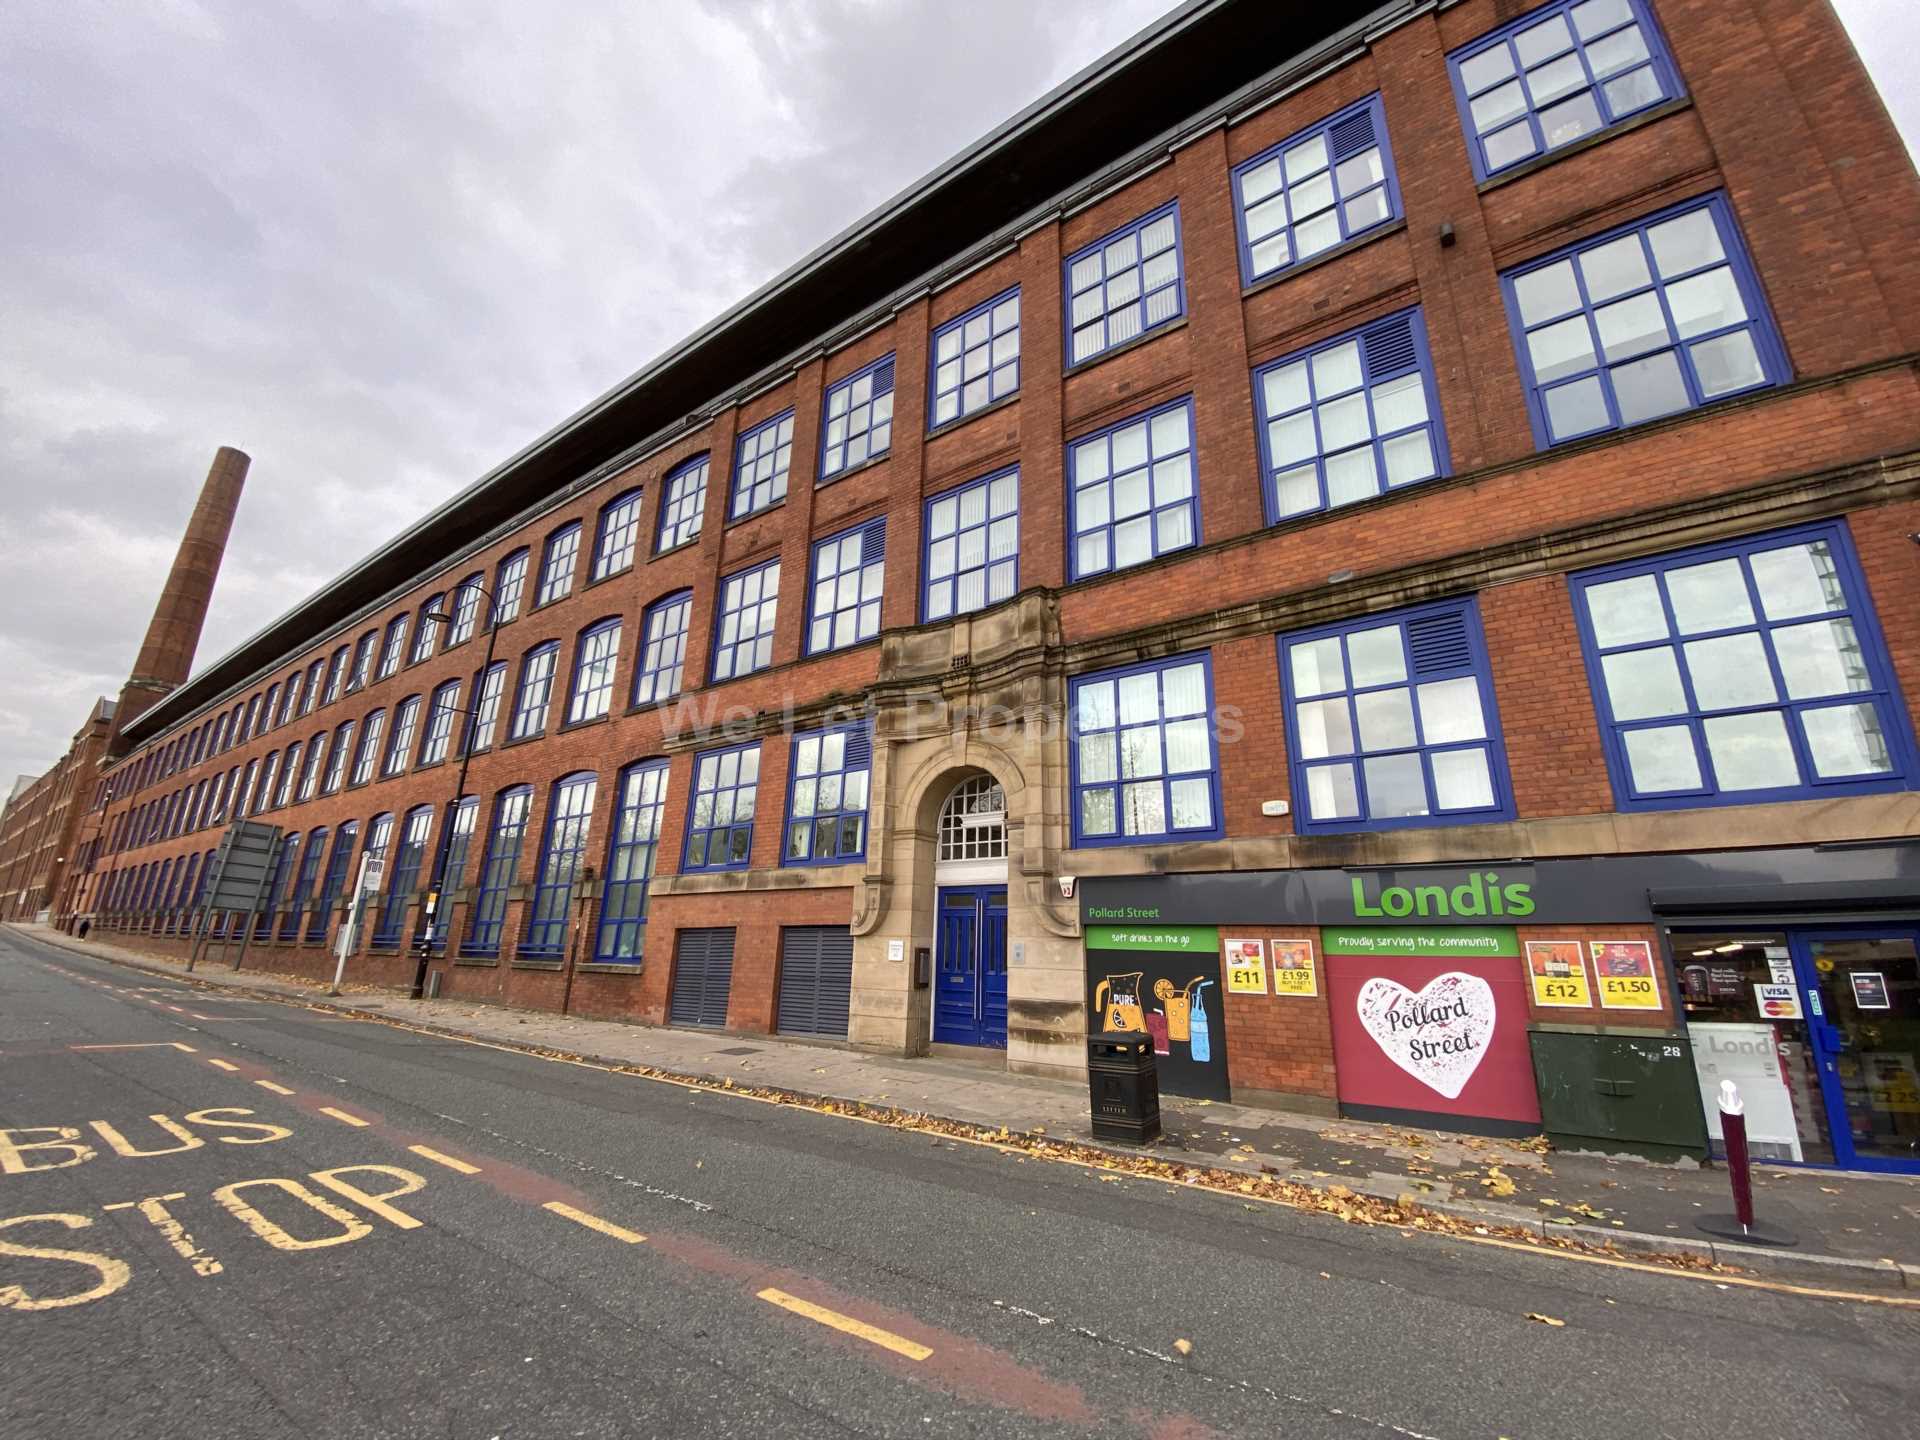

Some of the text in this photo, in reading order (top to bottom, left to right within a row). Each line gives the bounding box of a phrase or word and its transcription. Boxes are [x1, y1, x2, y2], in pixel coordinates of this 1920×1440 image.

[1351, 871, 1536, 918] Londis
[1089, 907, 1161, 918] Pollard Street
[1338, 936, 1499, 952] Proudly serving the community
[1234, 971, 1259, 984] £11
[1282, 971, 1309, 980] £1.99
[1546, 984, 1578, 998] £12
[1607, 981, 1651, 993] £1.50
[1765, 988, 1790, 996] VISA
[1113, 993, 1135, 1006] PURE
[1385, 996, 1469, 1032] Pollard
[1410, 1031, 1474, 1061] Street
[1662, 1045, 1681, 1057] 28
[0, 1108, 293, 1174] BUS
[0, 1164, 428, 1311] STOP
